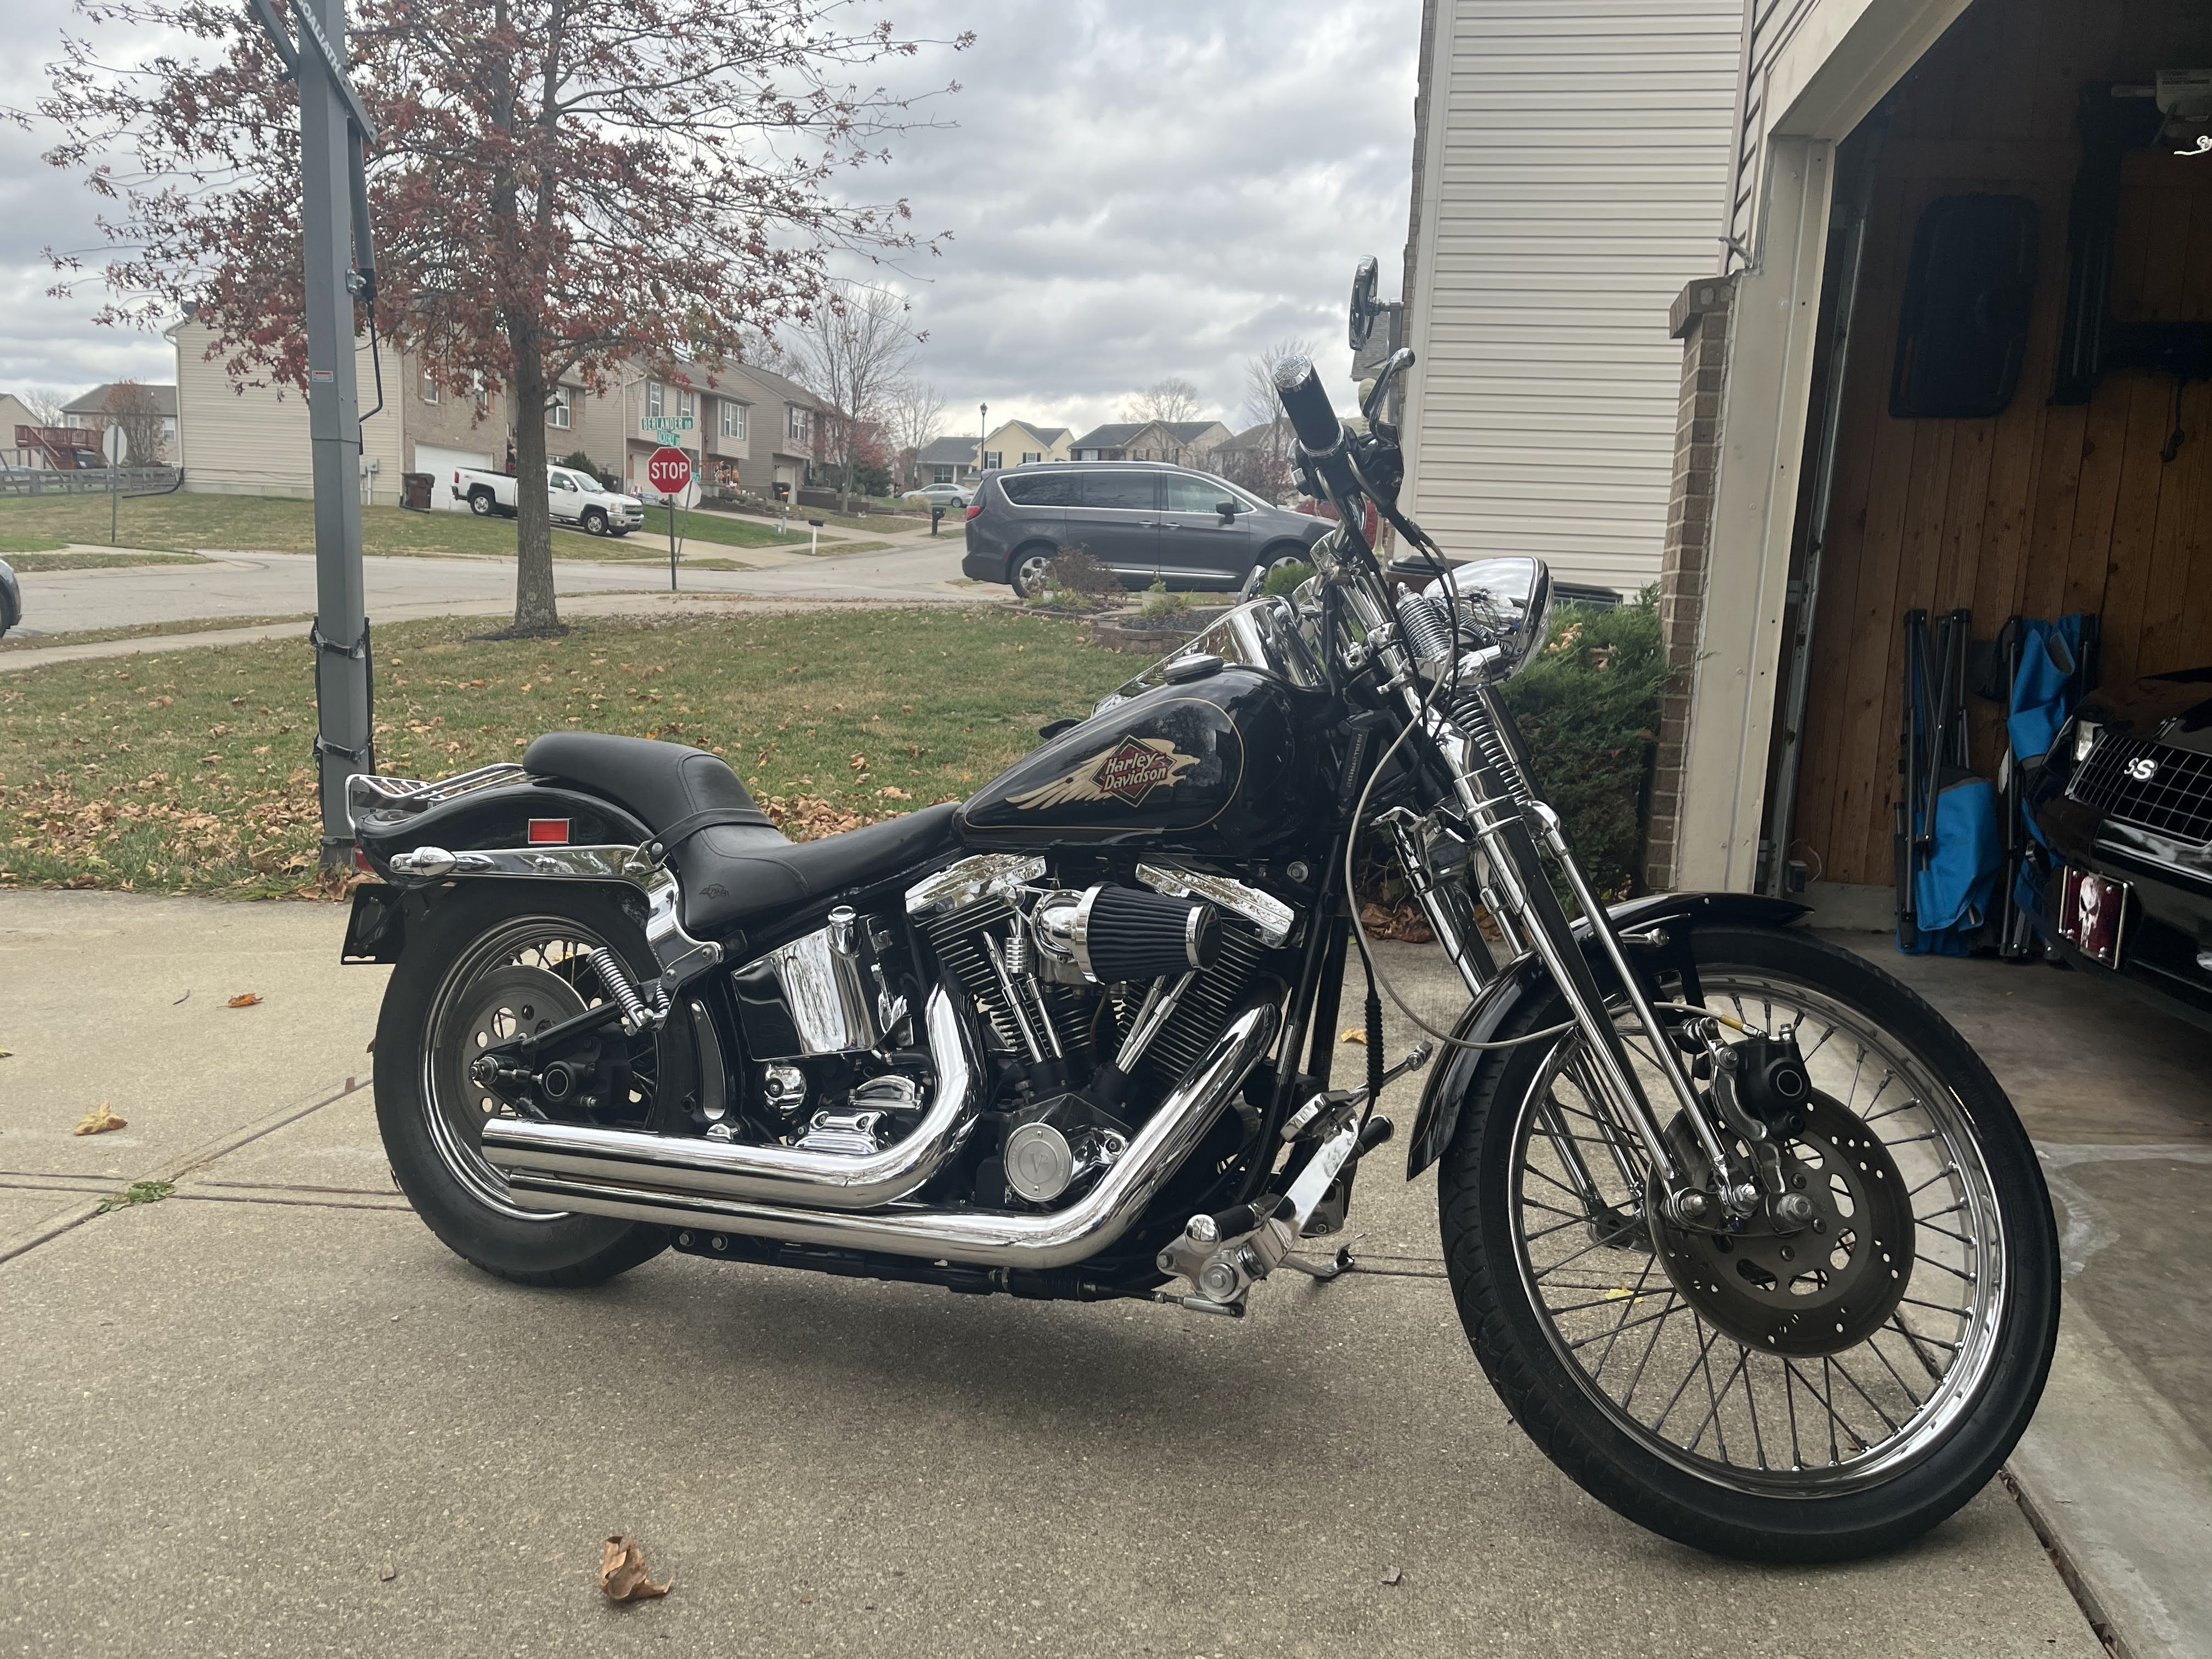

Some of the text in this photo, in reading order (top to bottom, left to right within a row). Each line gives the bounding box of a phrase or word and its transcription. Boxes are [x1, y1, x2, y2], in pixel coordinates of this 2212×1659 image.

[643, 417, 692, 430] BERLANDER DR
[651, 462, 688, 479] STOP
[1105, 752, 1165, 775] Harley-
[2124, 757, 2156, 780] SS
[1103, 767, 1167, 791] Davidson
